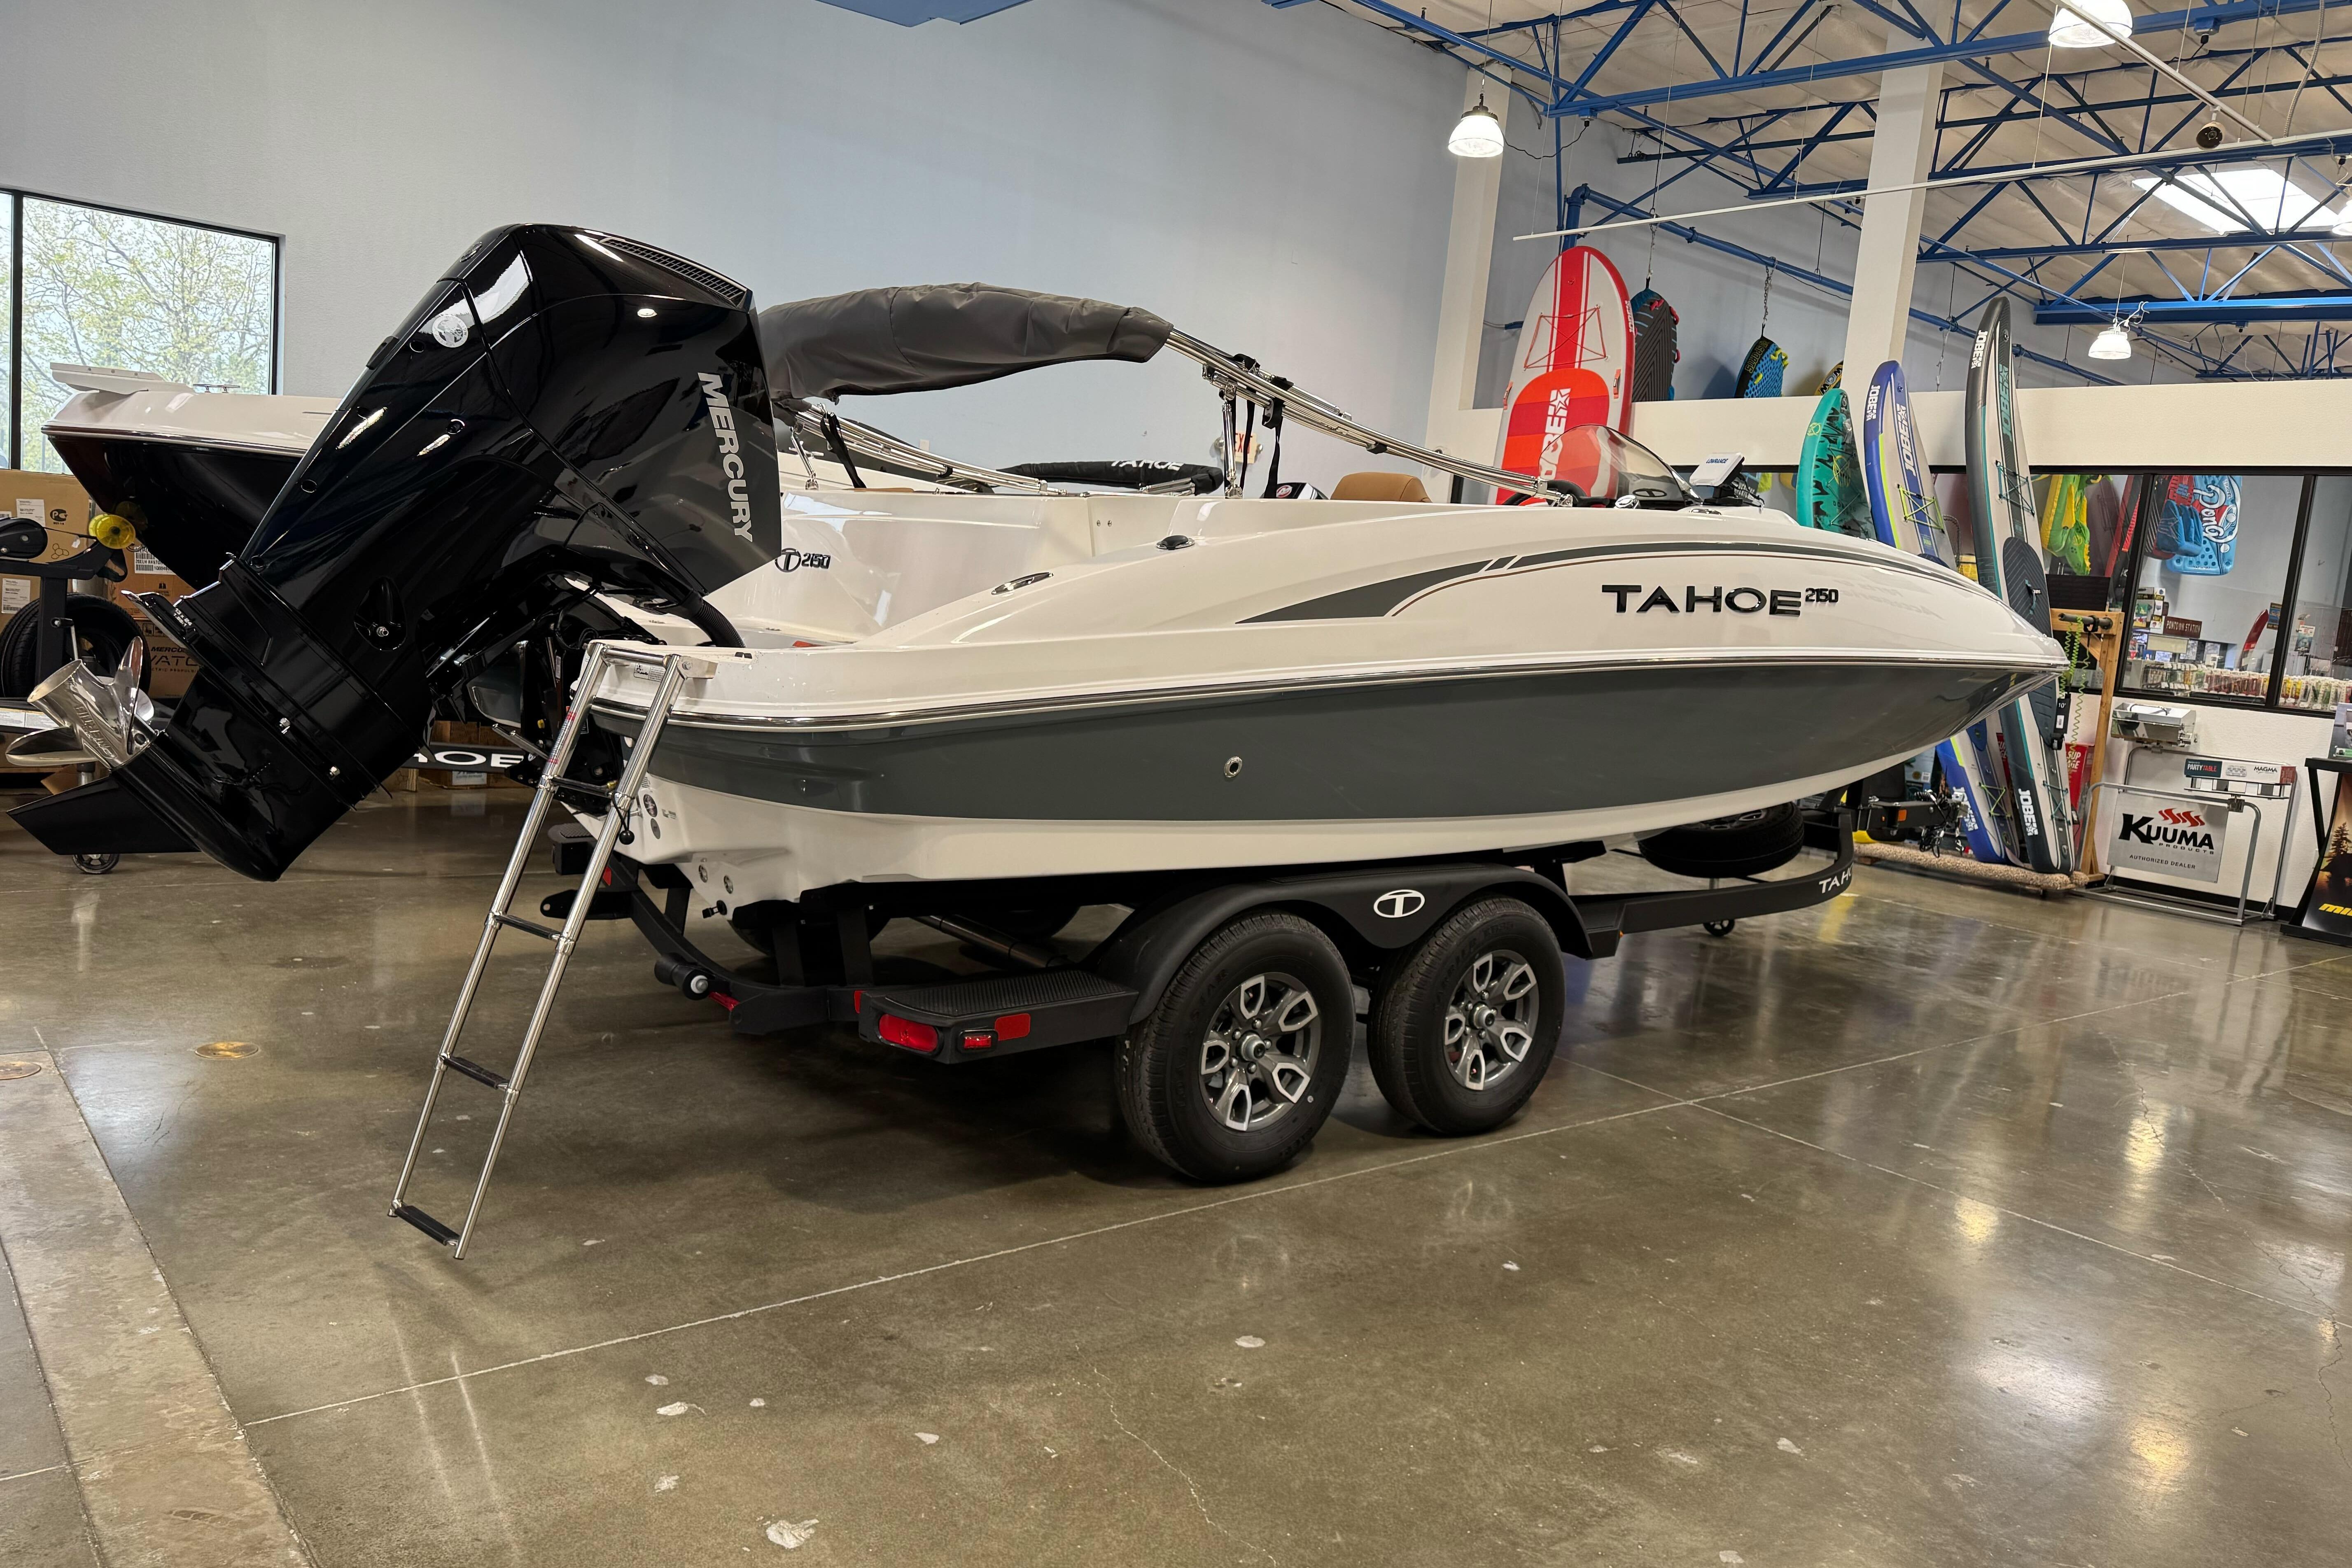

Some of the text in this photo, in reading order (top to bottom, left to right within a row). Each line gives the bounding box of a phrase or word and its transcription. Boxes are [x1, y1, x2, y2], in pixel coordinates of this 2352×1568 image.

[1972, 330, 1988, 359] JOBE
[1867, 385, 1881, 413] JOBE
[1999, 382, 2012, 442] JOBE
[698, 372, 753, 542] MERCURY
[1539, 415, 1567, 481] OBE
[1897, 420, 1916, 477] JOBE
[800, 552, 831, 569] 2150
[1602, 585, 1839, 617] TAHOE 2150
[2018, 788, 2036, 826] JOBE
[2119, 813, 2214, 850] KUUMA
[2158, 842, 2214, 855] PRODUCTS
[2129, 854, 2196, 870] AUTHORIZED DEALER
